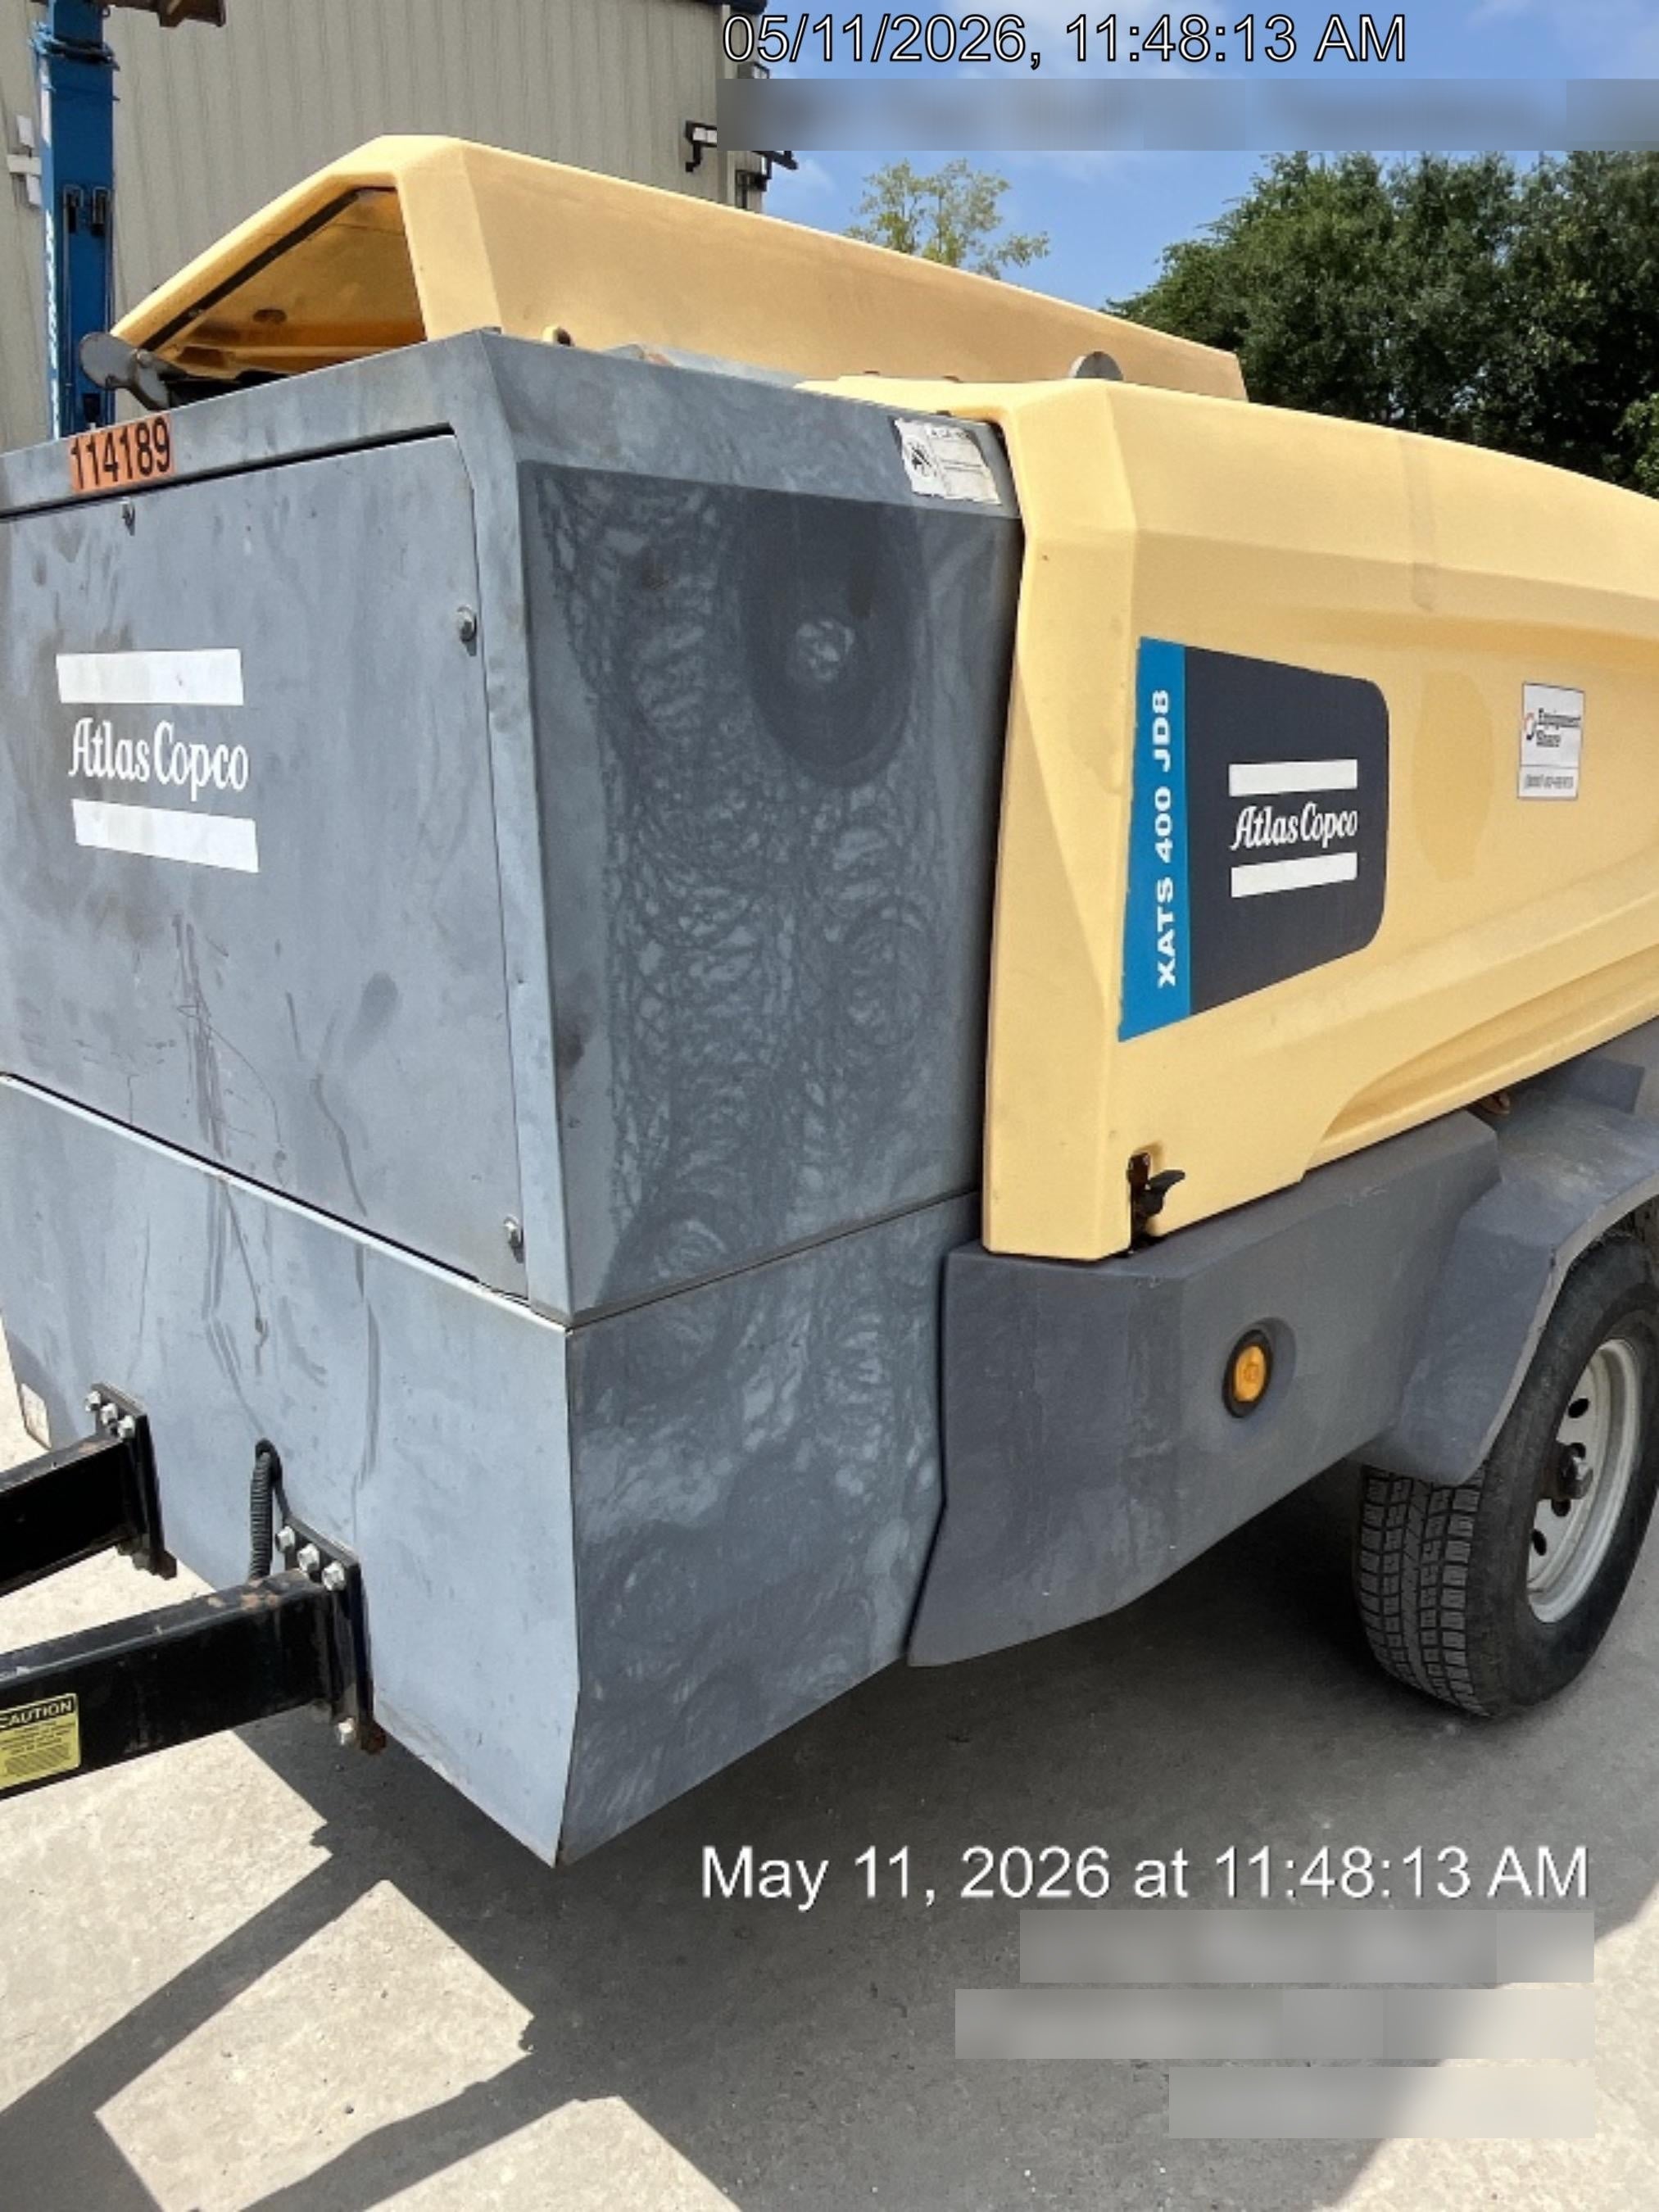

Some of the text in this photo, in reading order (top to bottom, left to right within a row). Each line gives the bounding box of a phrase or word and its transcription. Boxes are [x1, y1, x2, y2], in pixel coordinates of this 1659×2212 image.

[71, 416, 170, 490] 114189
[68, 717, 249, 802] Atlas Copco
[1152, 690, 1176, 990] XATS 400 JD8
[1229, 800, 1359, 851] Atlas Copco
